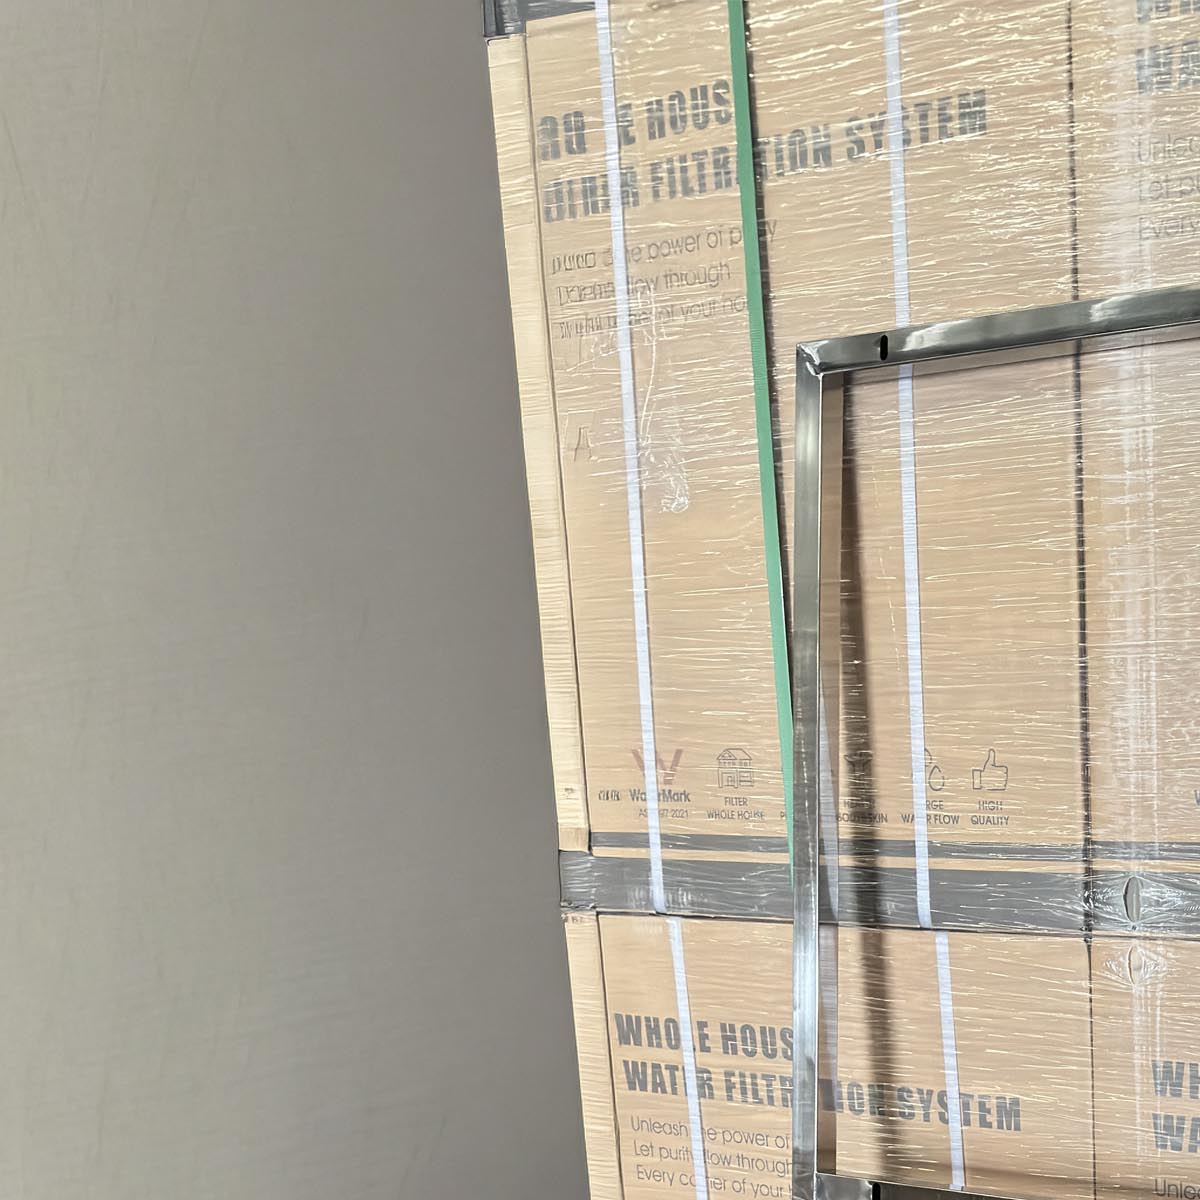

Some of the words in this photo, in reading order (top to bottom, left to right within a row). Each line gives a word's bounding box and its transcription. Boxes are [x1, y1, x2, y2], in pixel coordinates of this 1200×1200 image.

[646, 79, 732, 141] HOUS
[650, 124, 833, 200] FILTRTION
[648, 231, 701, 262] power
[664, 261, 731, 288] through
[629, 788, 691, 803] WarMark
[724, 797, 748, 807] FILTER
[926, 800, 944, 811] RGE
[978, 800, 1003, 811] HIGH
[707, 809, 736, 820] WHOLE
[901, 813, 932, 824] WAR
[934, 814, 960, 825] FLOW
[970, 814, 1010, 826] QUALITY
[614, 1012, 712, 1053] WHOE
[719, 1022, 794, 1062] HOUS
[723, 1069, 887, 1118] FILTRION
[896, 1086, 1022, 1132] SYSTEM
[631, 1115, 688, 1138] Unleash
[722, 1130, 769, 1148] power
[774, 1133, 790, 1149] of
[634, 1140, 655, 1157] Let
[658, 1145, 693, 1161] purit
[704, 1149, 731, 1166] low
[636, 1163, 675, 1187] Every
[732, 1178, 747, 1194] of
[750, 1181, 784, 1199] your
